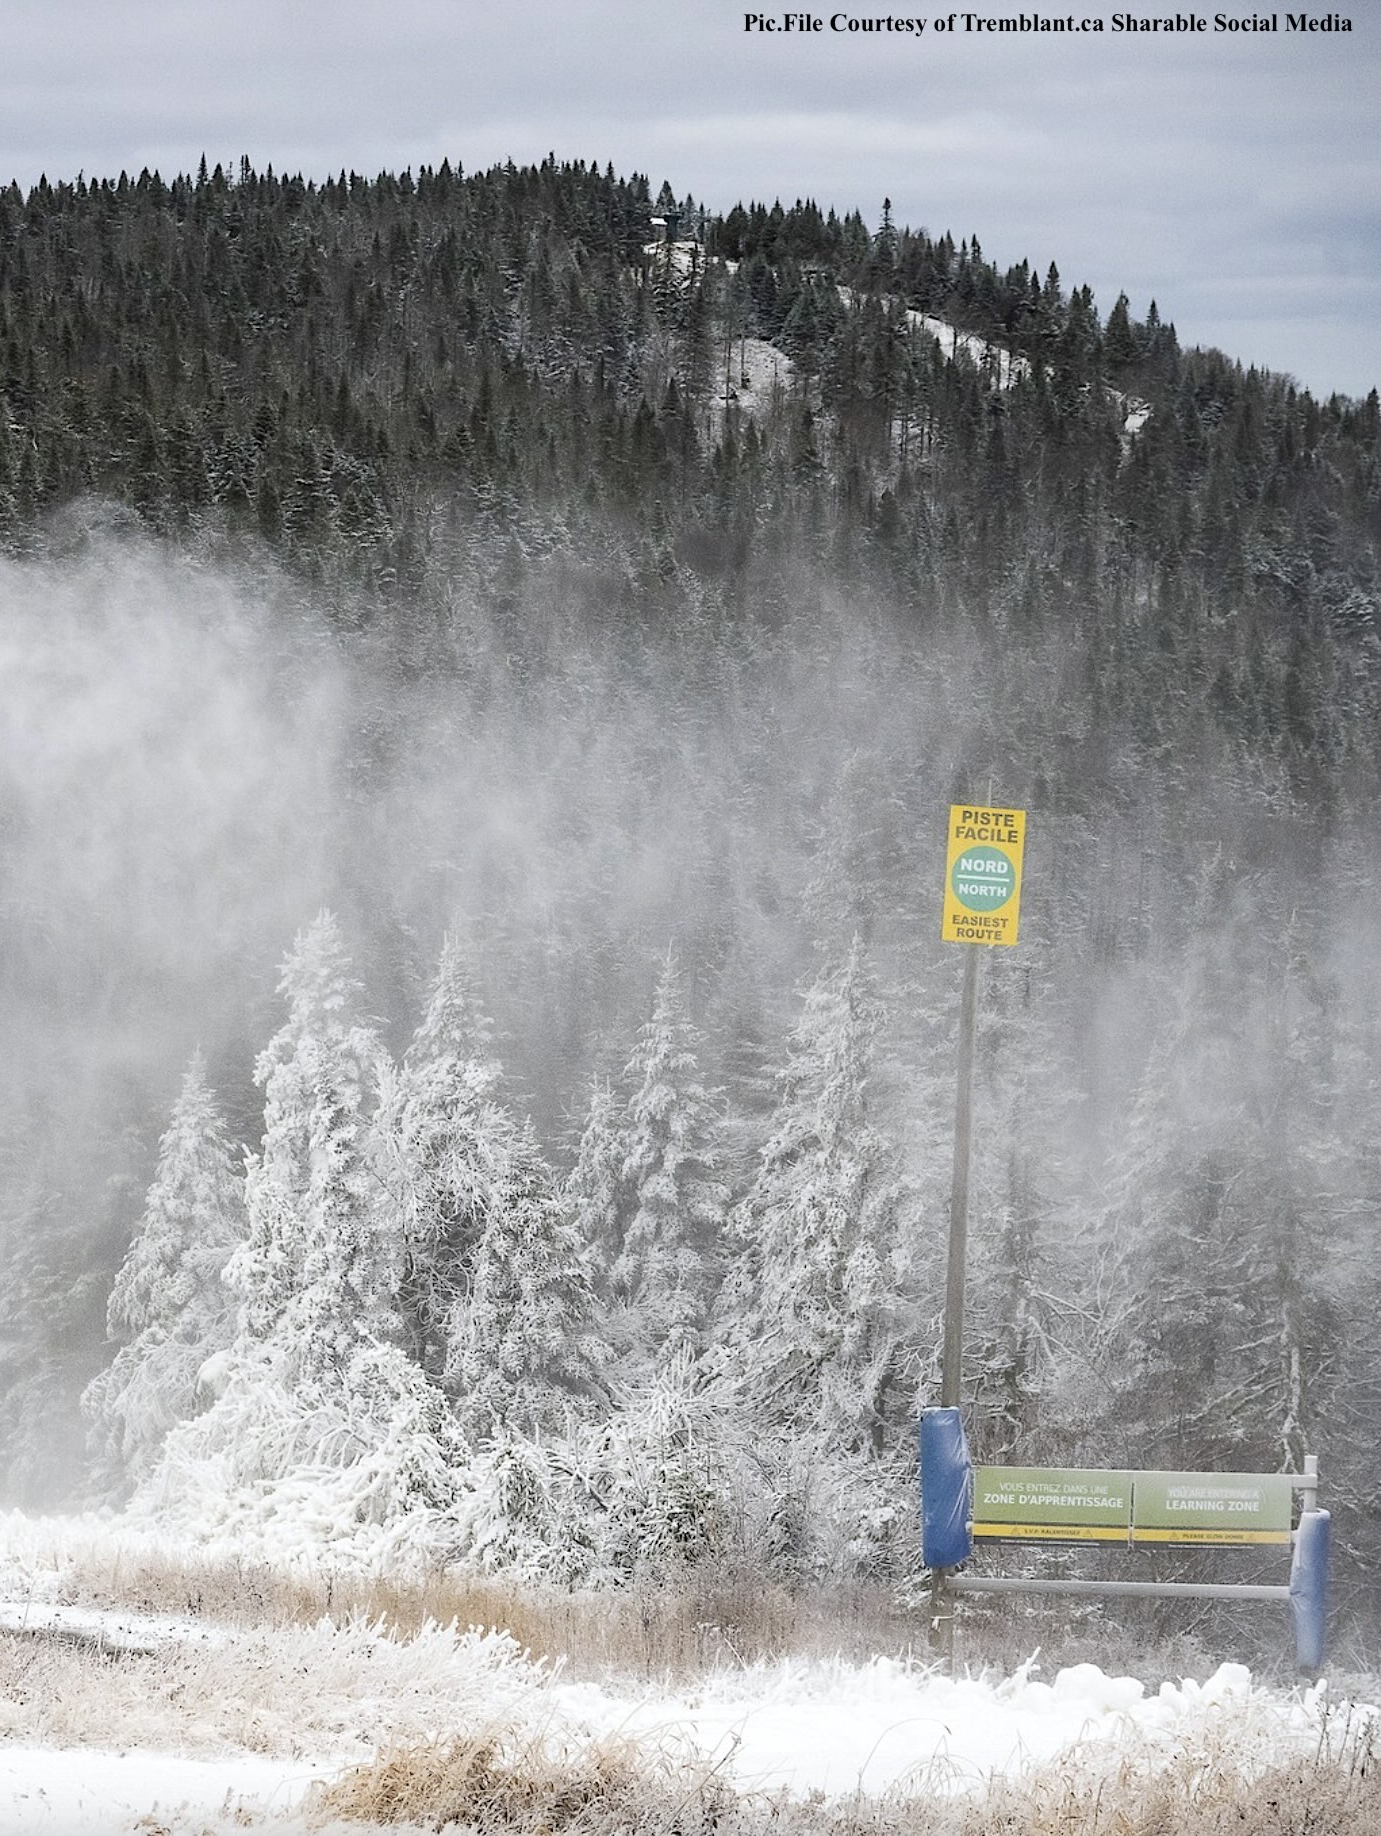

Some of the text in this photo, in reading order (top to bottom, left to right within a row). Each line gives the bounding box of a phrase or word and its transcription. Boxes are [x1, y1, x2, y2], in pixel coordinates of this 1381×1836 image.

[961, 810, 1015, 828] PISTE
[955, 826, 1019, 844] FACILE
[960, 858, 1008, 874] NORD
[958, 883, 1007, 897] NORTH
[952, 914, 1009, 928] EASIEST
[956, 928, 1003, 941] ROUTE
[999, 1482, 1108, 1495] VOUS ENTREZ DANS UNE
[983, 1493, 1124, 1508] ZONE D'APPRENTISSAGE
[1165, 1500, 1260, 1512] LEARNING ZONE
